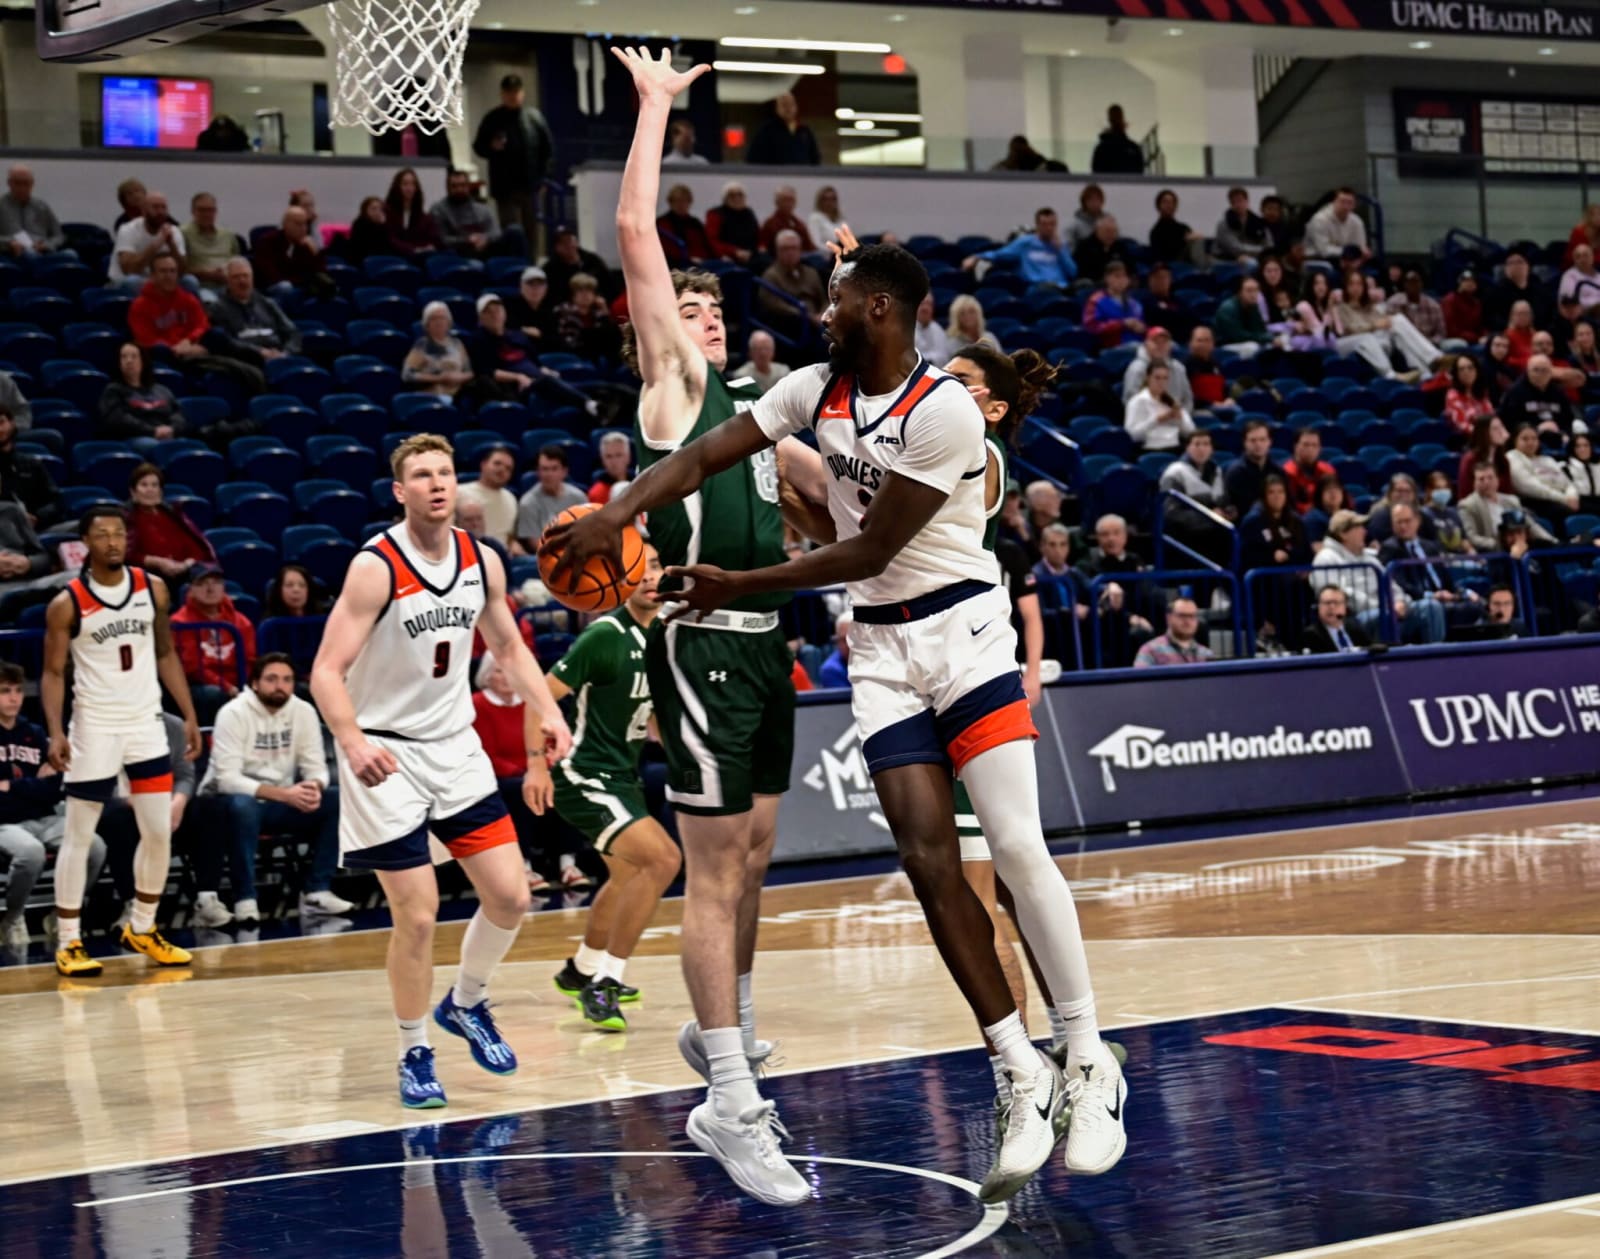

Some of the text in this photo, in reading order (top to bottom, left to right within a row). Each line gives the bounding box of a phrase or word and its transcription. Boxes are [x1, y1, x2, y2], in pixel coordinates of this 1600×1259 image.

[1392, 0, 1463, 29] UPMC
[404, 606, 476, 639] DUQUESNE
[119, 644, 133, 672] 0
[433, 640, 450, 679] 9
[1408, 688, 1565, 747] UPMC
[1129, 725, 1372, 769] DeanHonda.com
